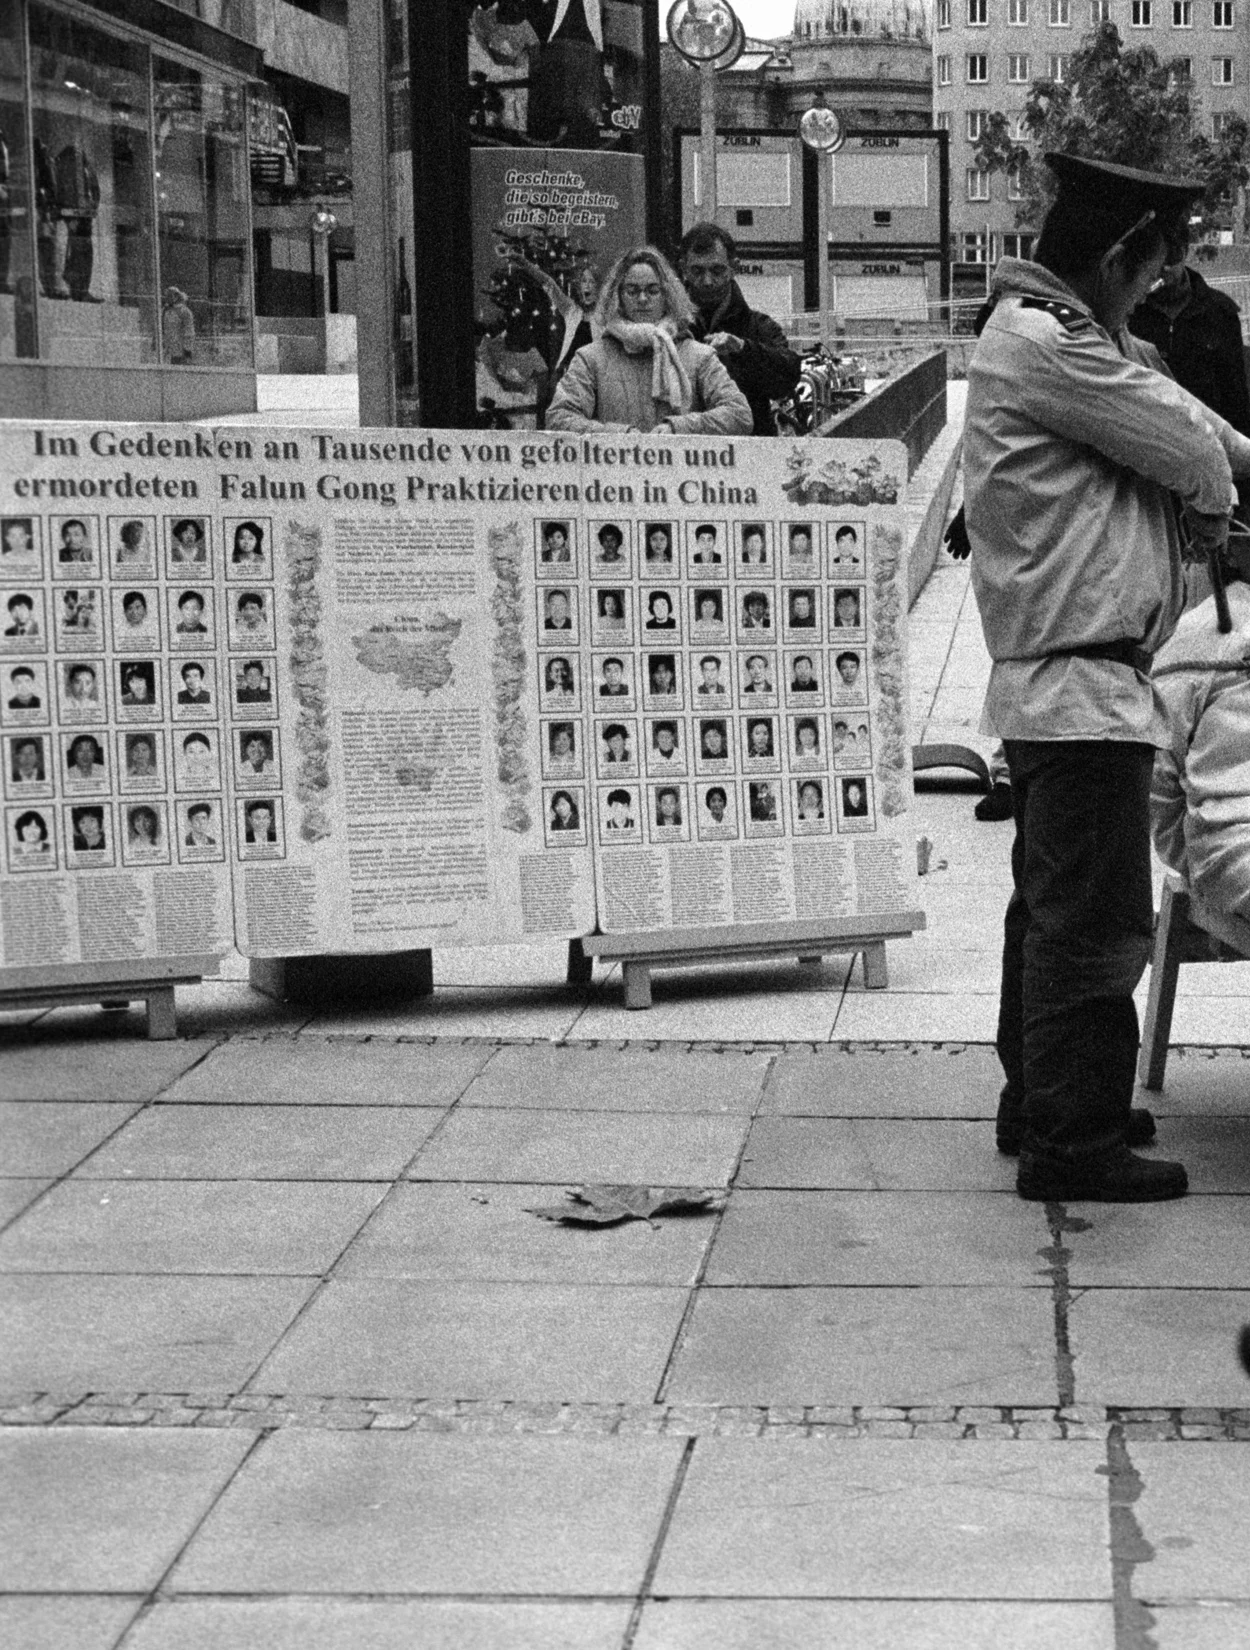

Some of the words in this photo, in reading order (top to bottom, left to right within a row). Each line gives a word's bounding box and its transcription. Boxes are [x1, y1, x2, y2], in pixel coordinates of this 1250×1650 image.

[505, 169, 586, 189] Geschenke,
[505, 188, 528, 205] die
[530, 191, 548, 204] so
[551, 189, 619, 210] begeistern,
[547, 209, 570, 225] bei
[34, 430, 79, 457] Im
[90, 430, 253, 460] Gedenken
[264, 440, 300, 461] an
[312, 435, 451, 462] Tausende
[460, 443, 511, 462] von
[521, 438, 673, 468] gefolterten
[684, 444, 736, 467] und
[14, 472, 198, 498] ermordeten
[219, 473, 306, 500] Falun
[317, 475, 396, 506] Gong
[406, 476, 633, 504] Praktizierenden
[643, 480, 668, 503] in
[678, 478, 758, 504] China
